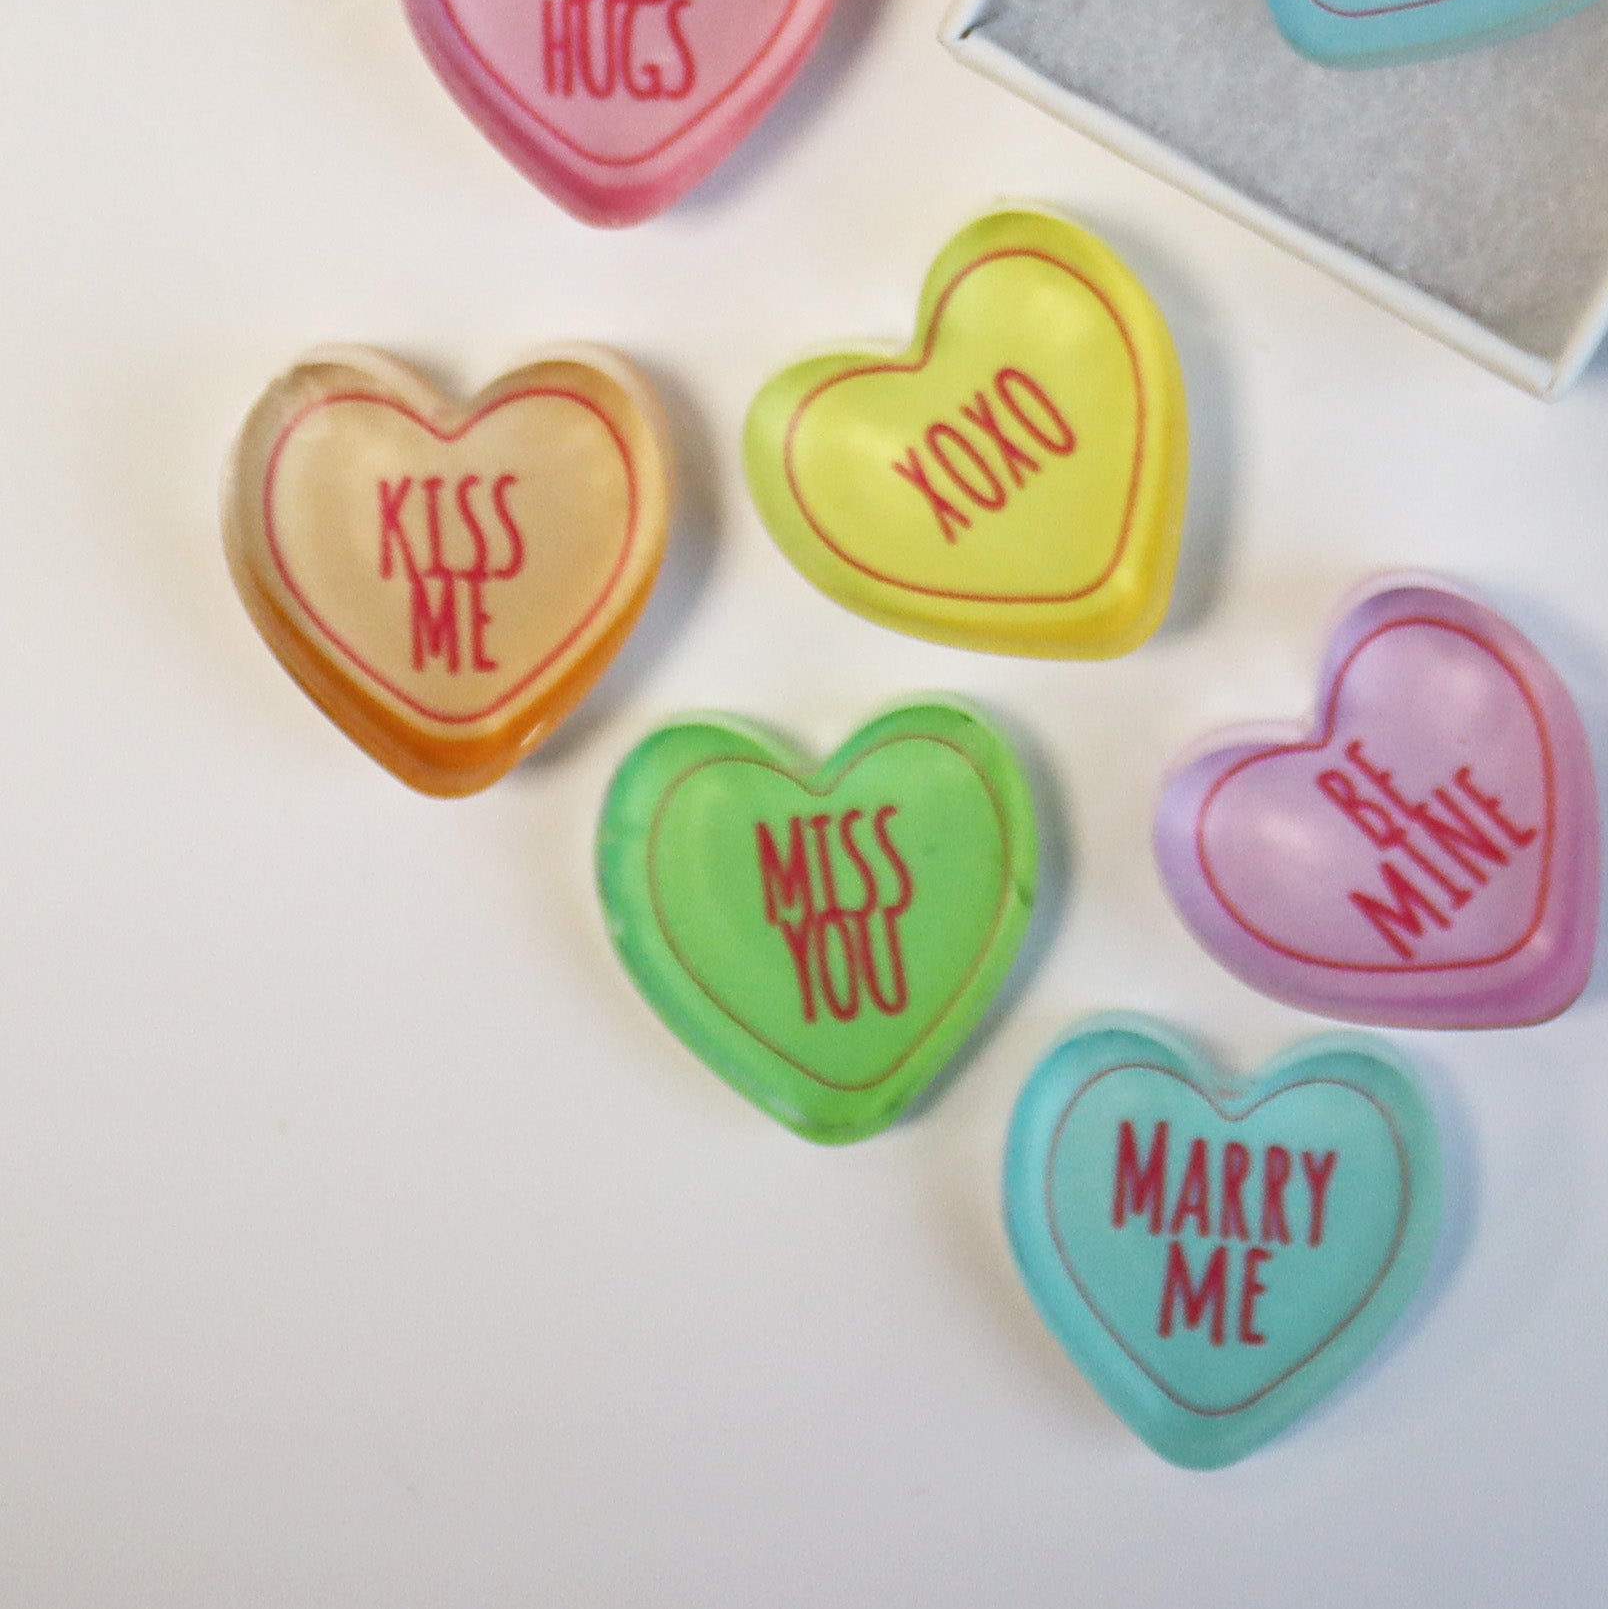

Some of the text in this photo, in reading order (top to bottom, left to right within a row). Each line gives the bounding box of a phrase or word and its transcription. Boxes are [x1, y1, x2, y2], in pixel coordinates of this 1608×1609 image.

[892, 368, 1078, 544] XOXO
[378, 475, 526, 581] KISS
[410, 570, 499, 674] ME
[1315, 739, 1430, 846] BE
[755, 804, 913, 924] MISS
[1349, 765, 1538, 960] MINE
[778, 906, 910, 1024] YOU
[1110, 1120, 1337, 1248] MARRY
[1157, 1240, 1274, 1347] ME
